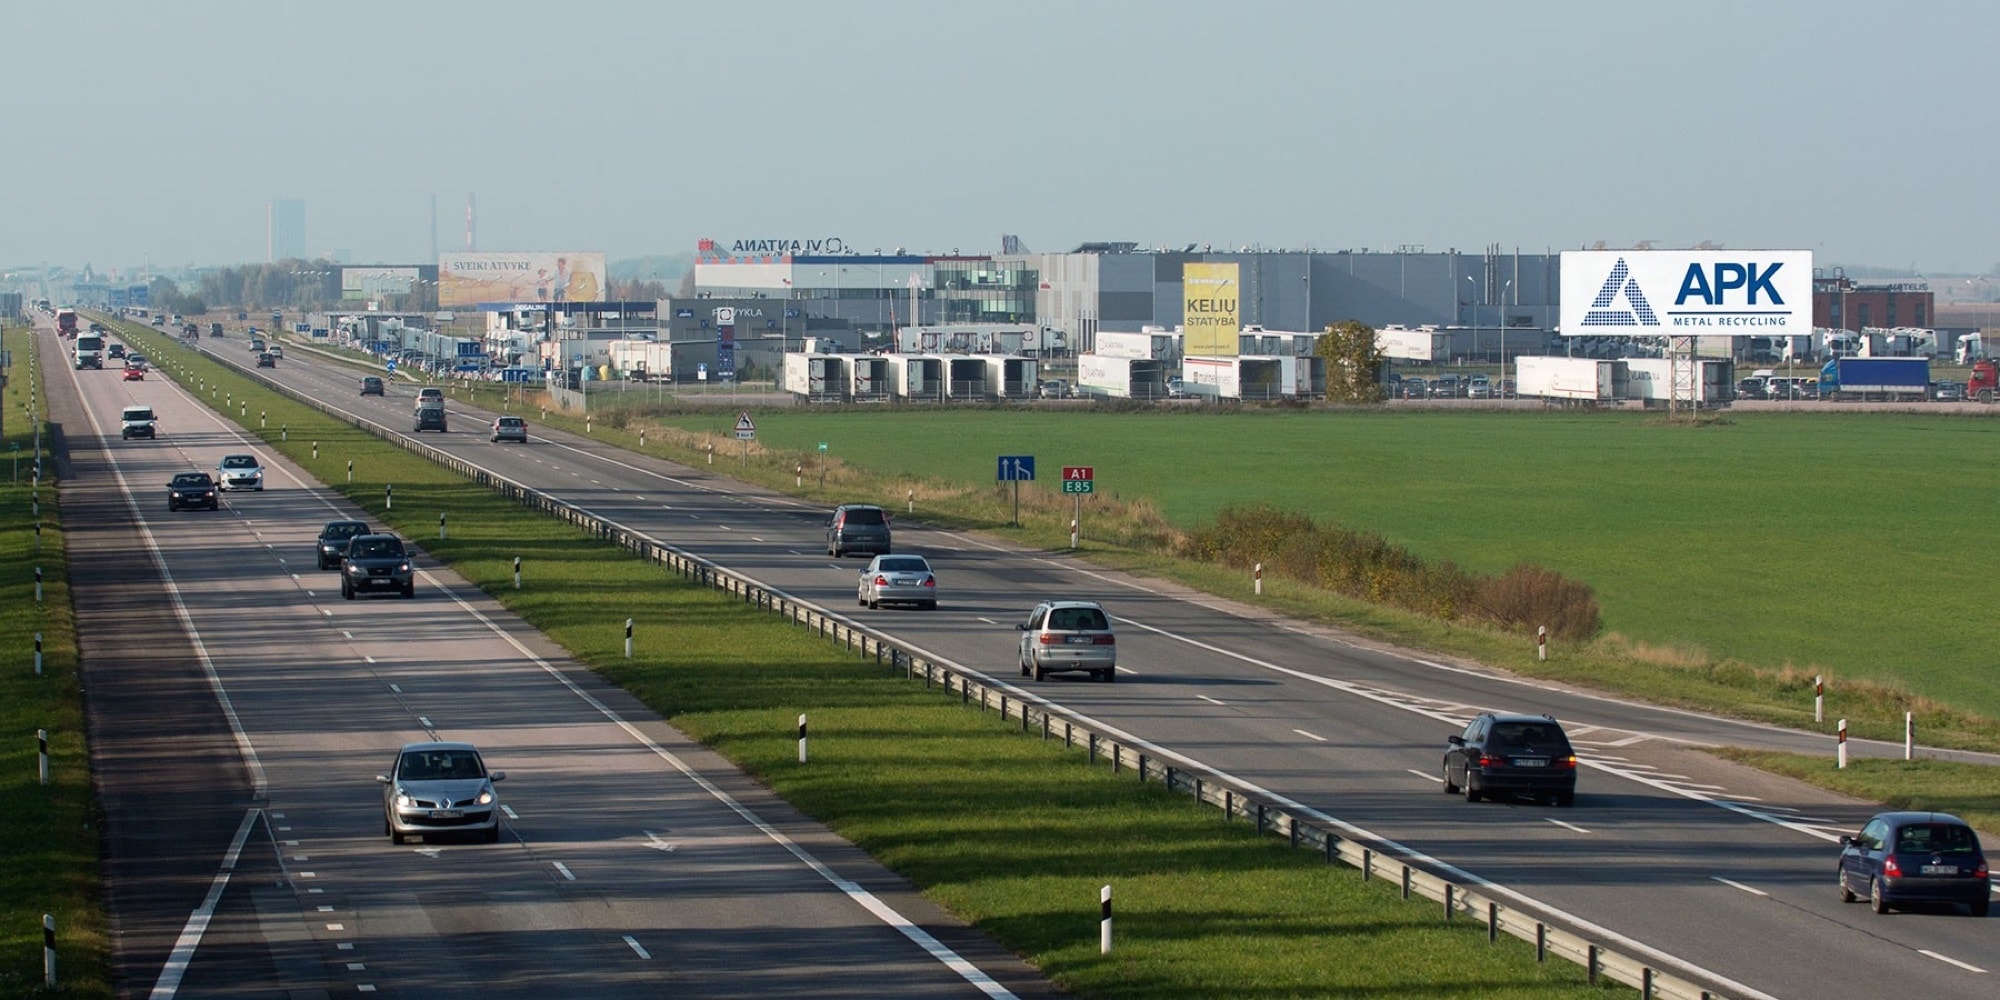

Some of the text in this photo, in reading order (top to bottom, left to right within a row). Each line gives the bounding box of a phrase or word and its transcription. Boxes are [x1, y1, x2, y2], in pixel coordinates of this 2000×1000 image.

[453, 261, 487, 271] SVEIKI
[1674, 262, 1785, 305] APK
[1187, 299, 1236, 315] KELIŲ
[712, 308, 763, 318] PVYKLA
[1187, 317, 1236, 326] STATYBA
[1673, 316, 1788, 326] METAL RECYCLING
[1071, 468, 1086, 479] A1
[1066, 481, 1090, 492] E85
